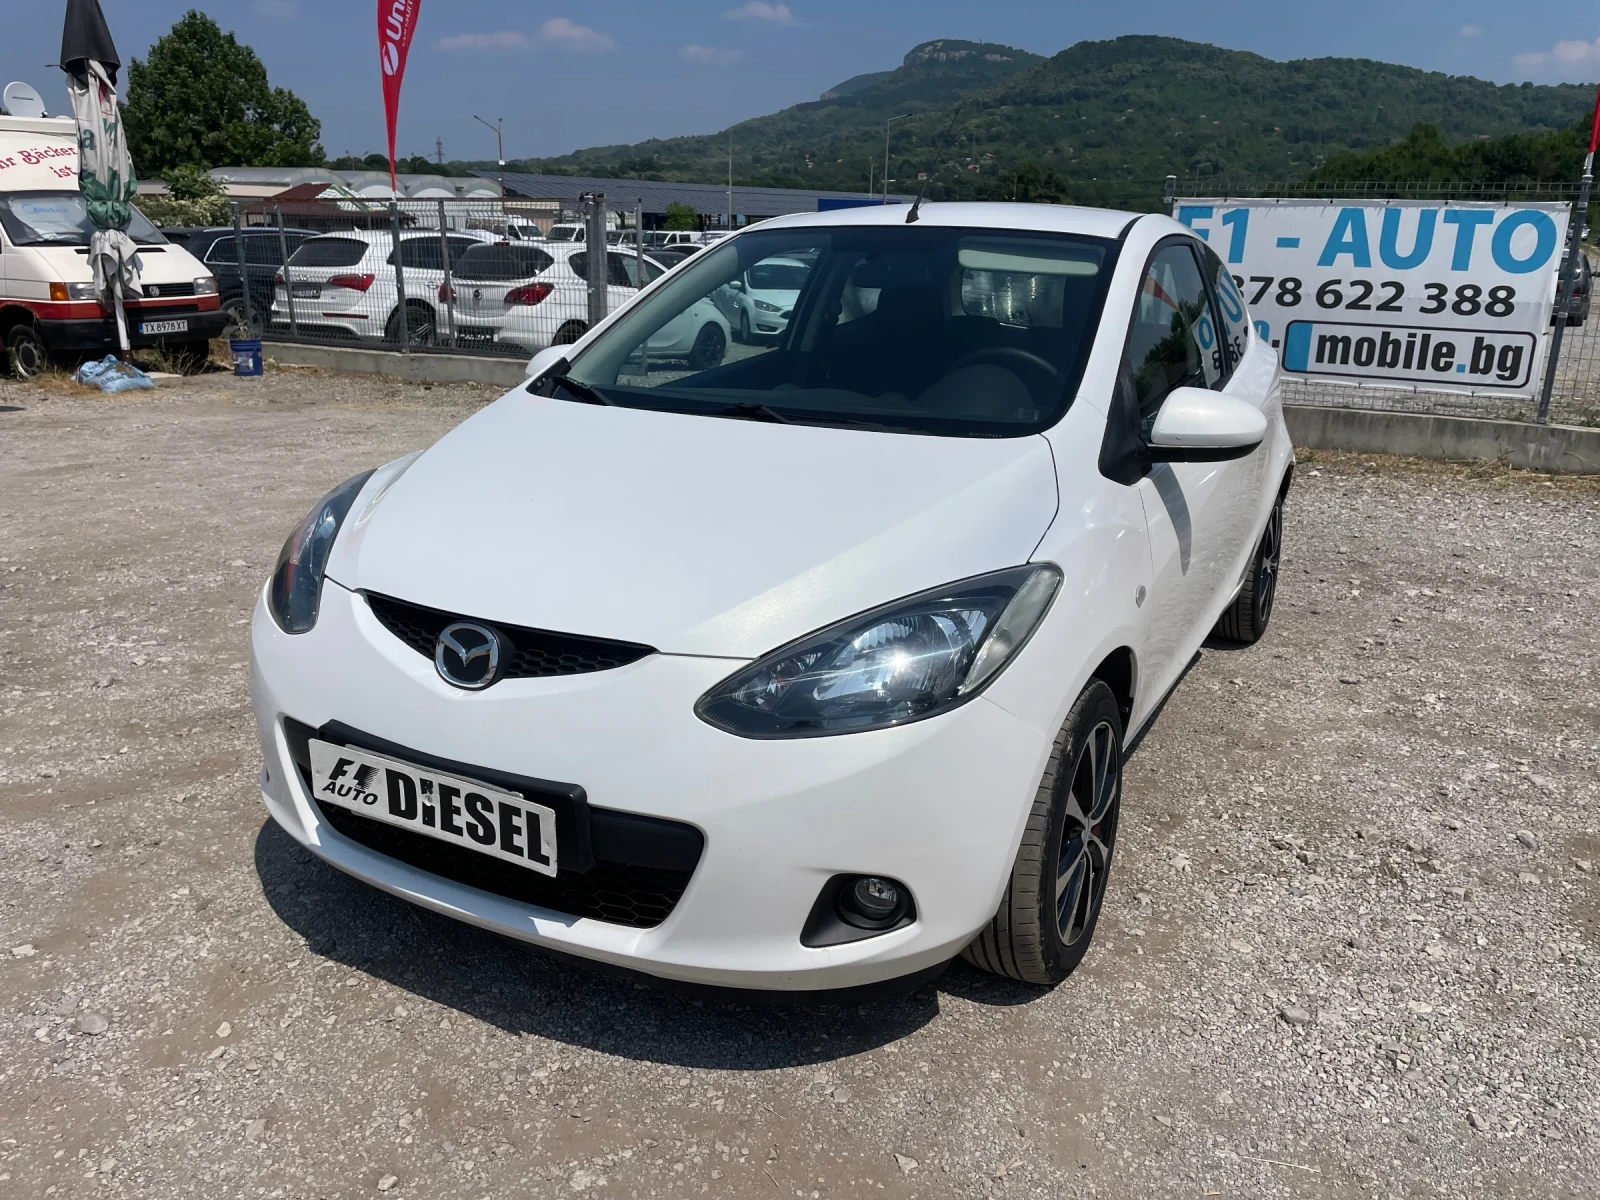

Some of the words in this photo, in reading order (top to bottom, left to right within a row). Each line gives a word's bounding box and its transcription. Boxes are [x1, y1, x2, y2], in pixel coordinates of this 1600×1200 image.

[17, 146, 77, 164] Bäcker
[49, 166, 77, 178] ist
[1178, 206, 1250, 263] F1
[1317, 207, 1557, 274] AUTO
[1315, 278, 1405, 312] 622
[1419, 282, 1516, 317] 388
[144, 323, 155, 333] TX
[156, 322, 175, 332] 8978
[1315, 331, 1524, 381] mobile.bg
[322, 781, 378, 806] AUTO
